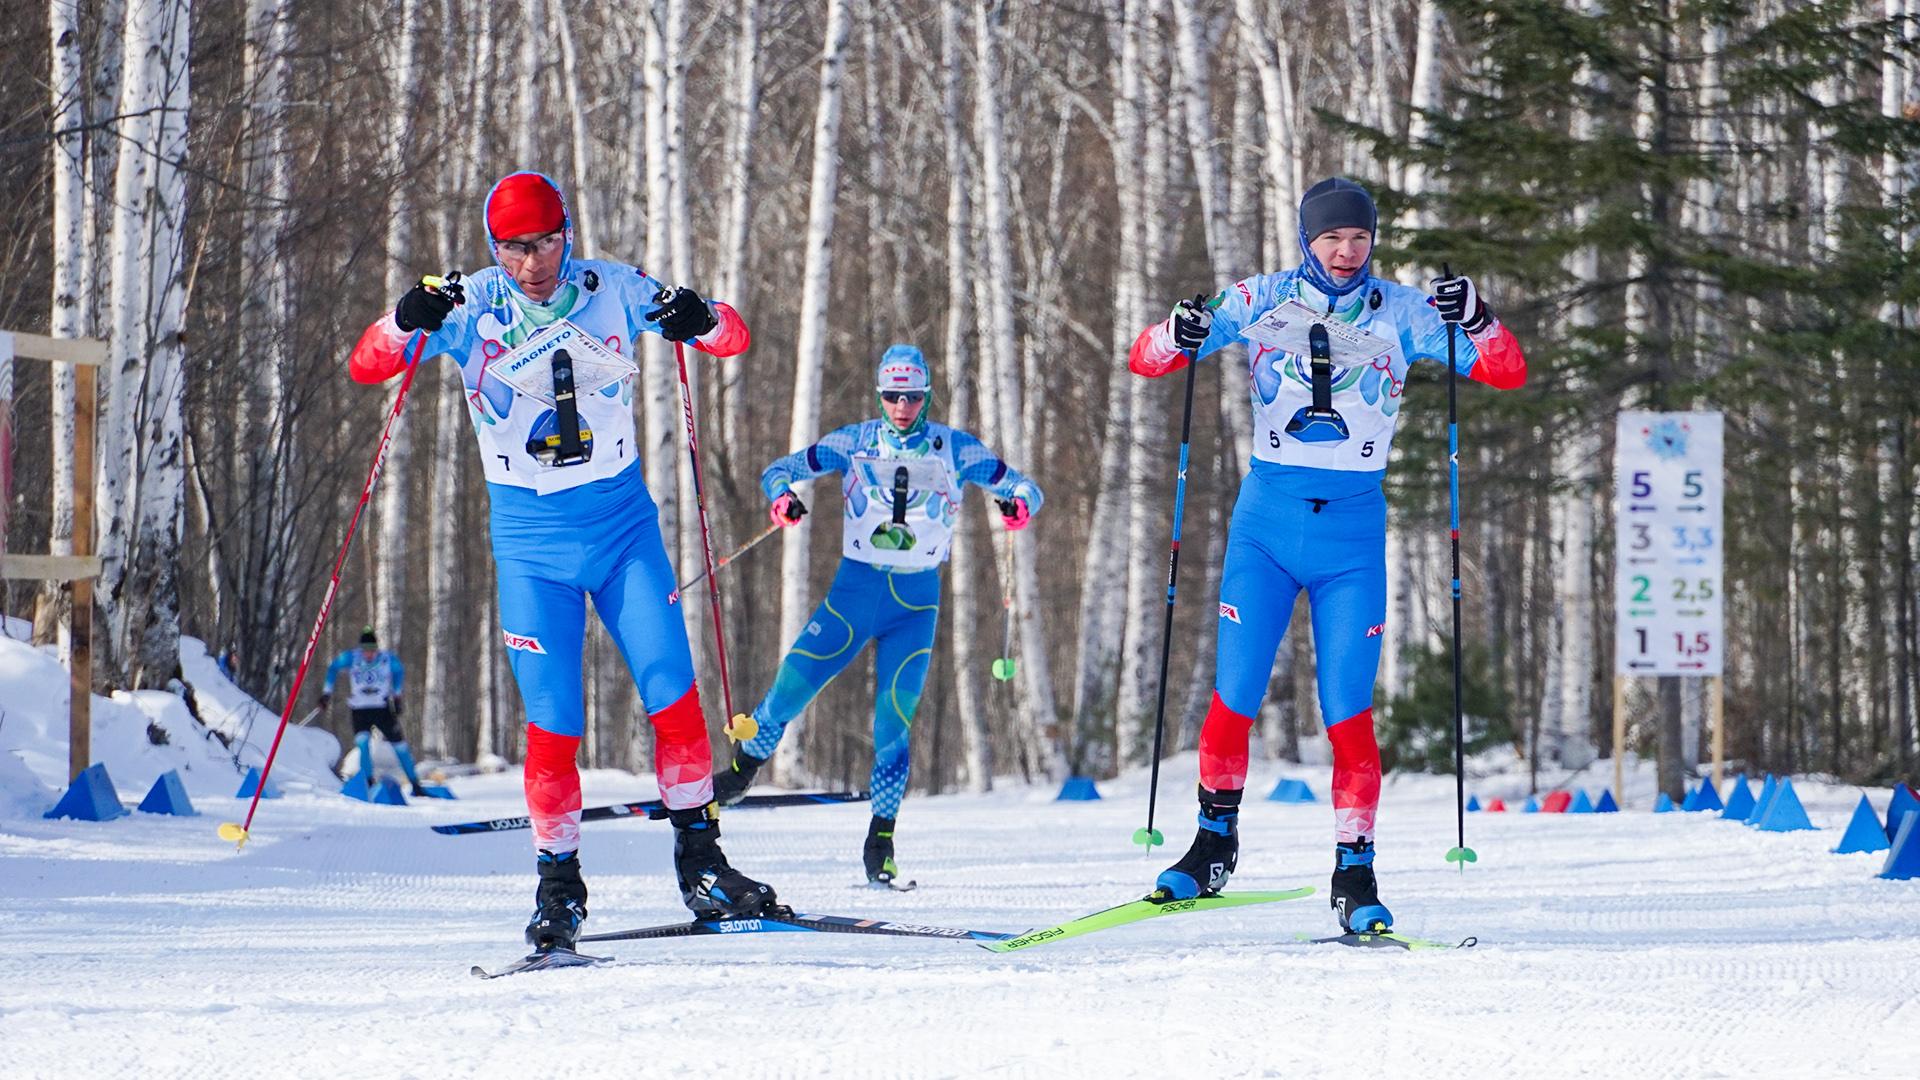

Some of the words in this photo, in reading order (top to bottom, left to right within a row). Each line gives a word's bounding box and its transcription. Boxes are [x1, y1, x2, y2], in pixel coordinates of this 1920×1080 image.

[511, 330, 571, 372] MAGNETO
[1269, 430, 1281, 449] 5
[1361, 441, 1375, 458] 5
[497, 454, 510, 472] 7
[1631, 472, 1652, 498] 5
[1684, 472, 1703, 498] 5
[1631, 524, 1651, 550] 3
[1673, 526, 1714, 551] 3,3
[1631, 576, 1651, 602] 2
[1673, 579, 1714, 602] 2,5
[503, 632, 540, 650] KFA
[1635, 629, 1647, 654] 1
[1674, 633, 1710, 657] 1,5
[1159, 900, 1197, 915] FISCHER
[1006, 927, 1064, 949] FISCHER
